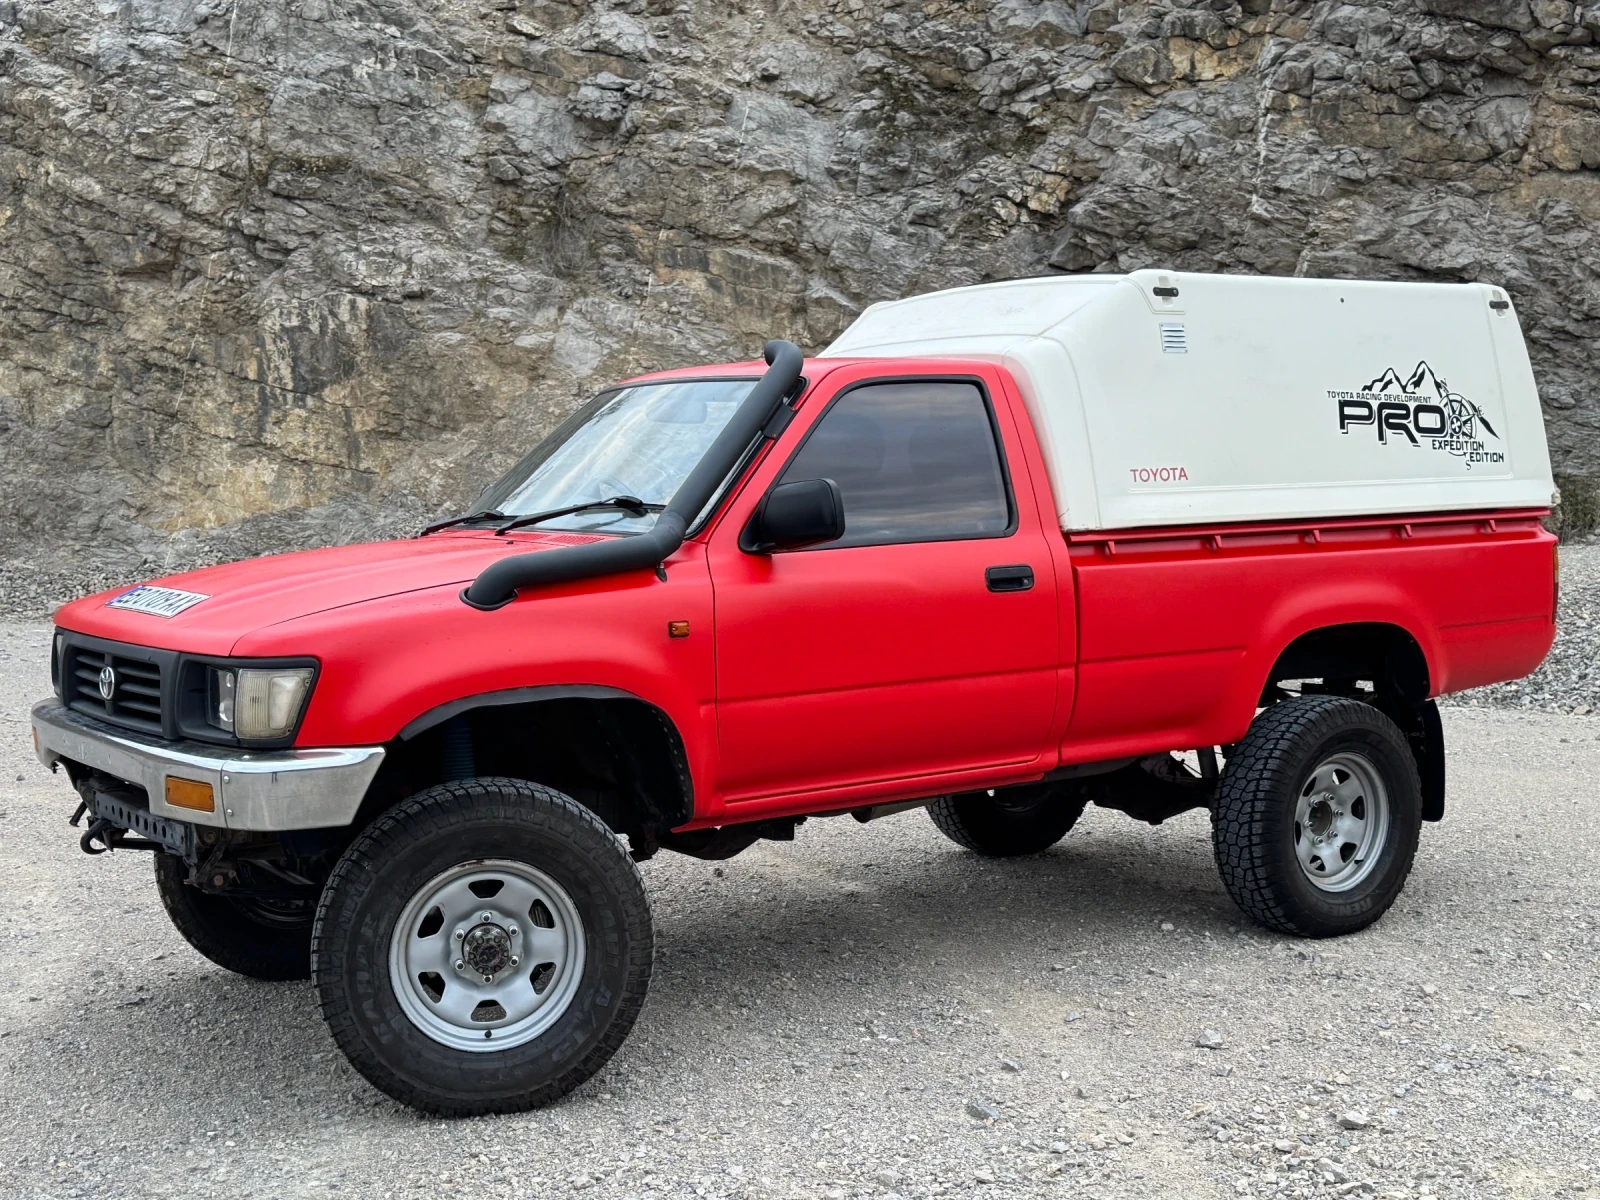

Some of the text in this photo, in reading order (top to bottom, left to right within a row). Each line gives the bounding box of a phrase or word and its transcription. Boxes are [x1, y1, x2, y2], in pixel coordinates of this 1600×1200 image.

[1327, 390, 1431, 404] TOYOTA RACING DEVELOPMENT
[1338, 399, 1448, 447] PRO
[1432, 439, 1484, 452] EXPEDITION
[1469, 452, 1504, 463] EDITION
[1130, 467, 1189, 483] TOYOTA
